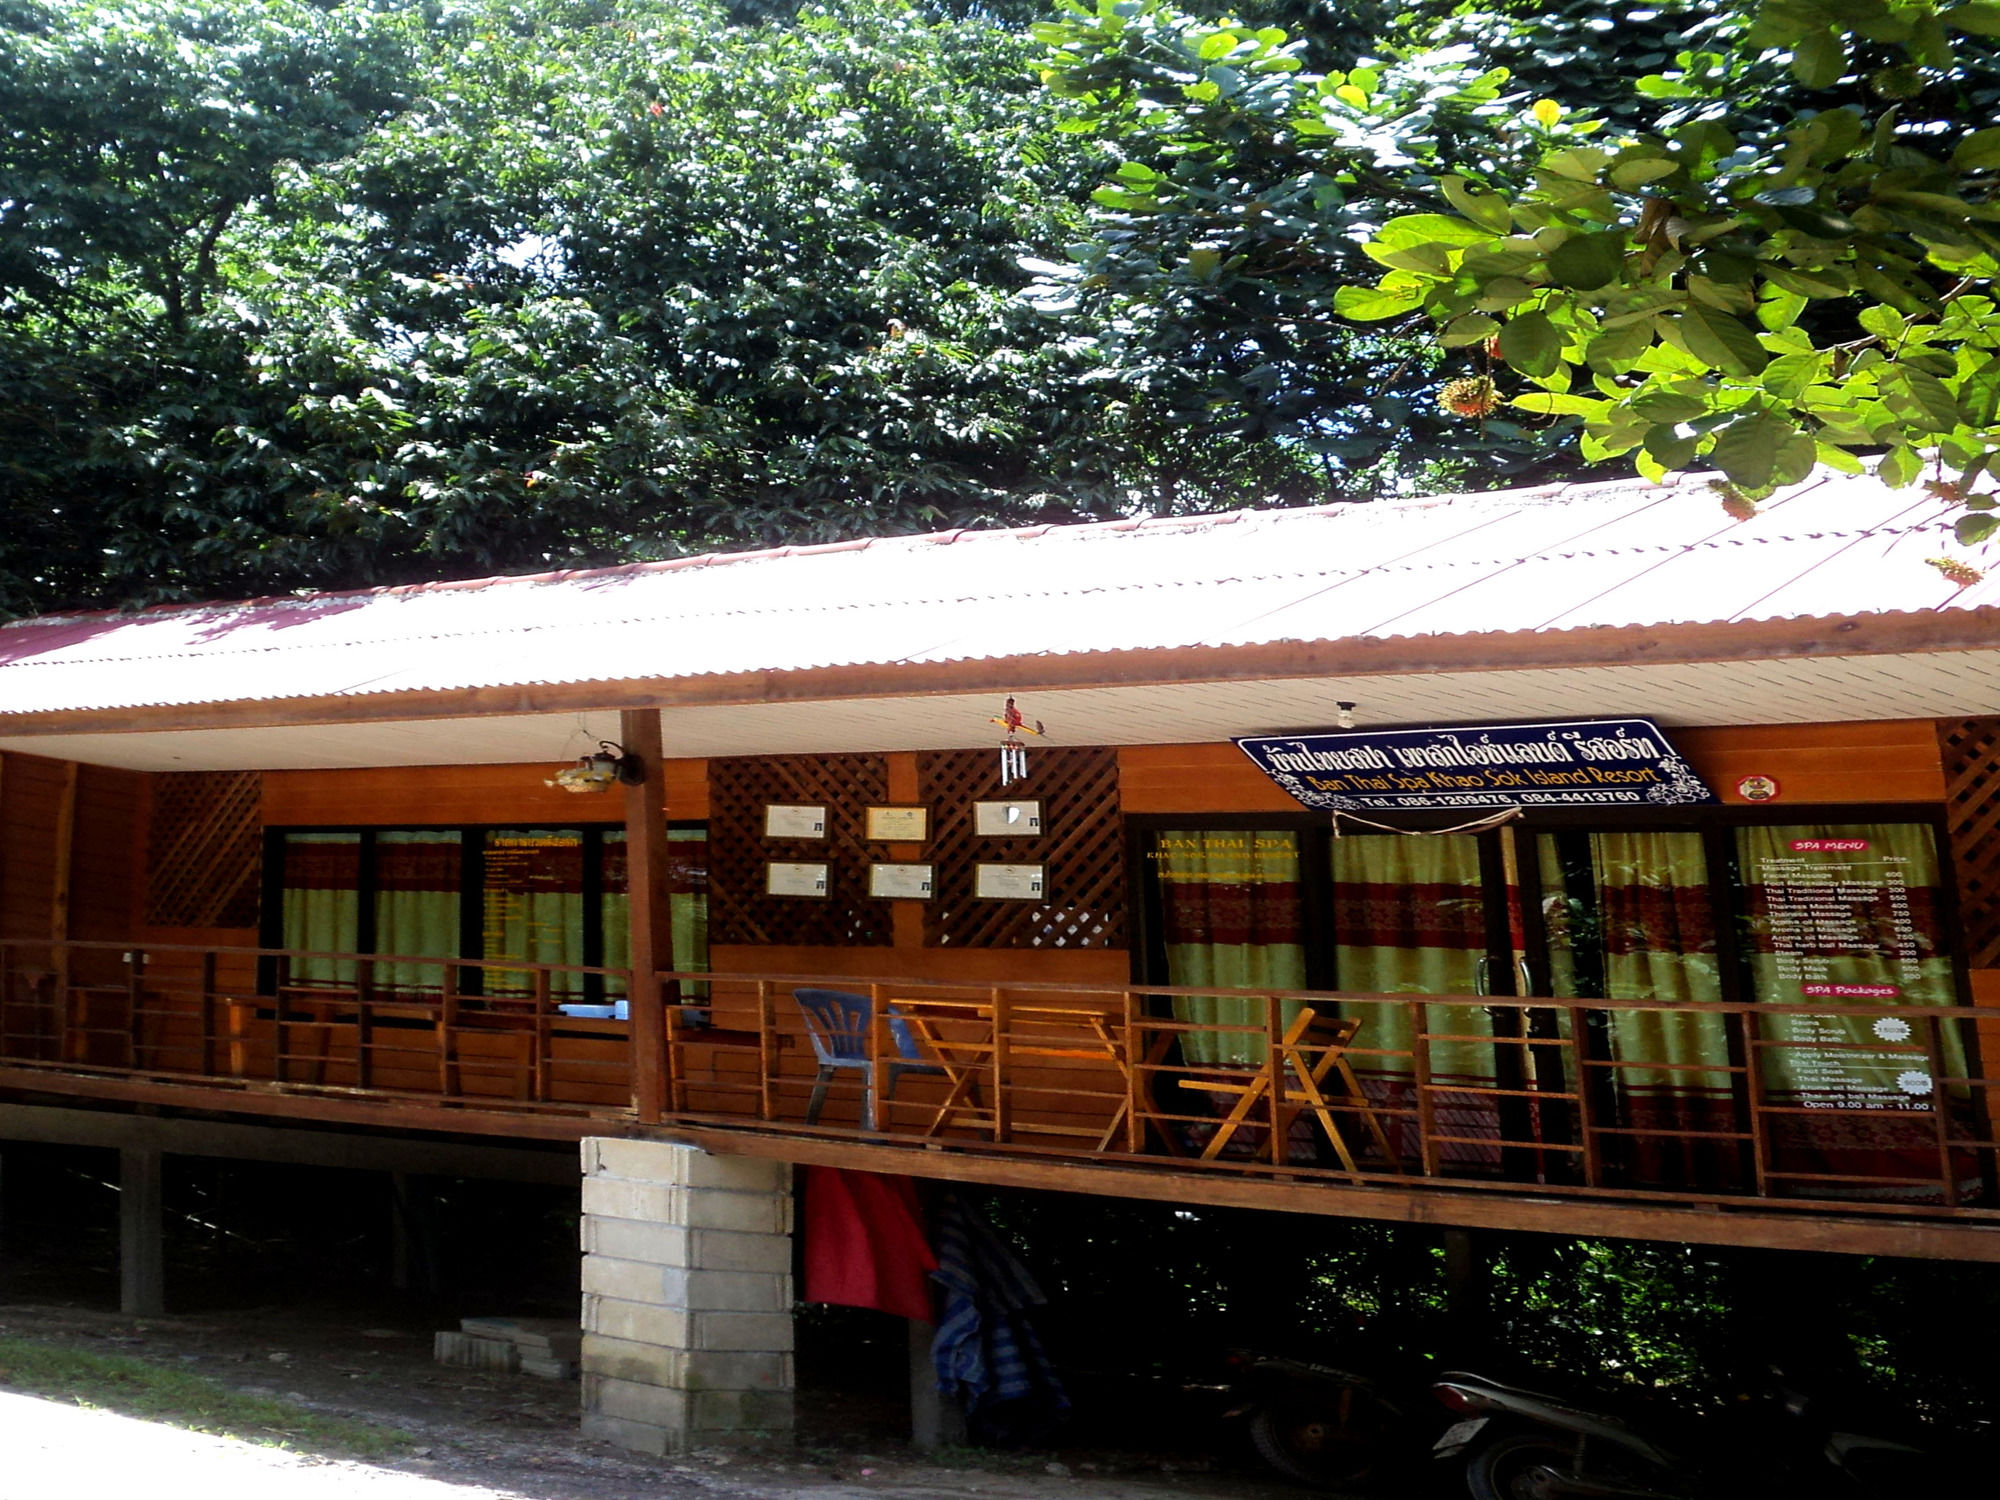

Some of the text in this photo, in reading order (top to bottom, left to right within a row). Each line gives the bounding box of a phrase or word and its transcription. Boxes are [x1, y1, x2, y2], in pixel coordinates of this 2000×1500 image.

[1261, 741, 1396, 772] บ้านไทยสปา
[1561, 727, 1661, 761] รีสอร์ท
[1305, 766, 1662, 791] Ban Thai Spa Khao Sok Island Resort
[1360, 797, 1396, 807] Tel.
[1520, 791, 1641, 803] 084-4413760
[1161, 839, 1293, 848] BAN THAI SPA
[1795, 841, 1865, 850] SPA MENU
[1841, 880, 1884, 888] Massage
[1836, 887, 1879, 895] Massage
[1838, 895, 1880, 903] Massage
[1809, 903, 1851, 911] Massage
[1818, 934, 1860, 942] Massage
[1838, 942, 1880, 950] Massage
[1806, 985, 1895, 997] SPA Packages
[1821, 1076, 1863, 1084] Massage
[1847, 1085, 1889, 1093] Massage
[1867, 1094, 1911, 1102] Massage
[1803, 1101, 1835, 1109] Open
[1837, 1101, 1863, 1109] 9.00
[1898, 1103, 1930, 1111] 11.00
